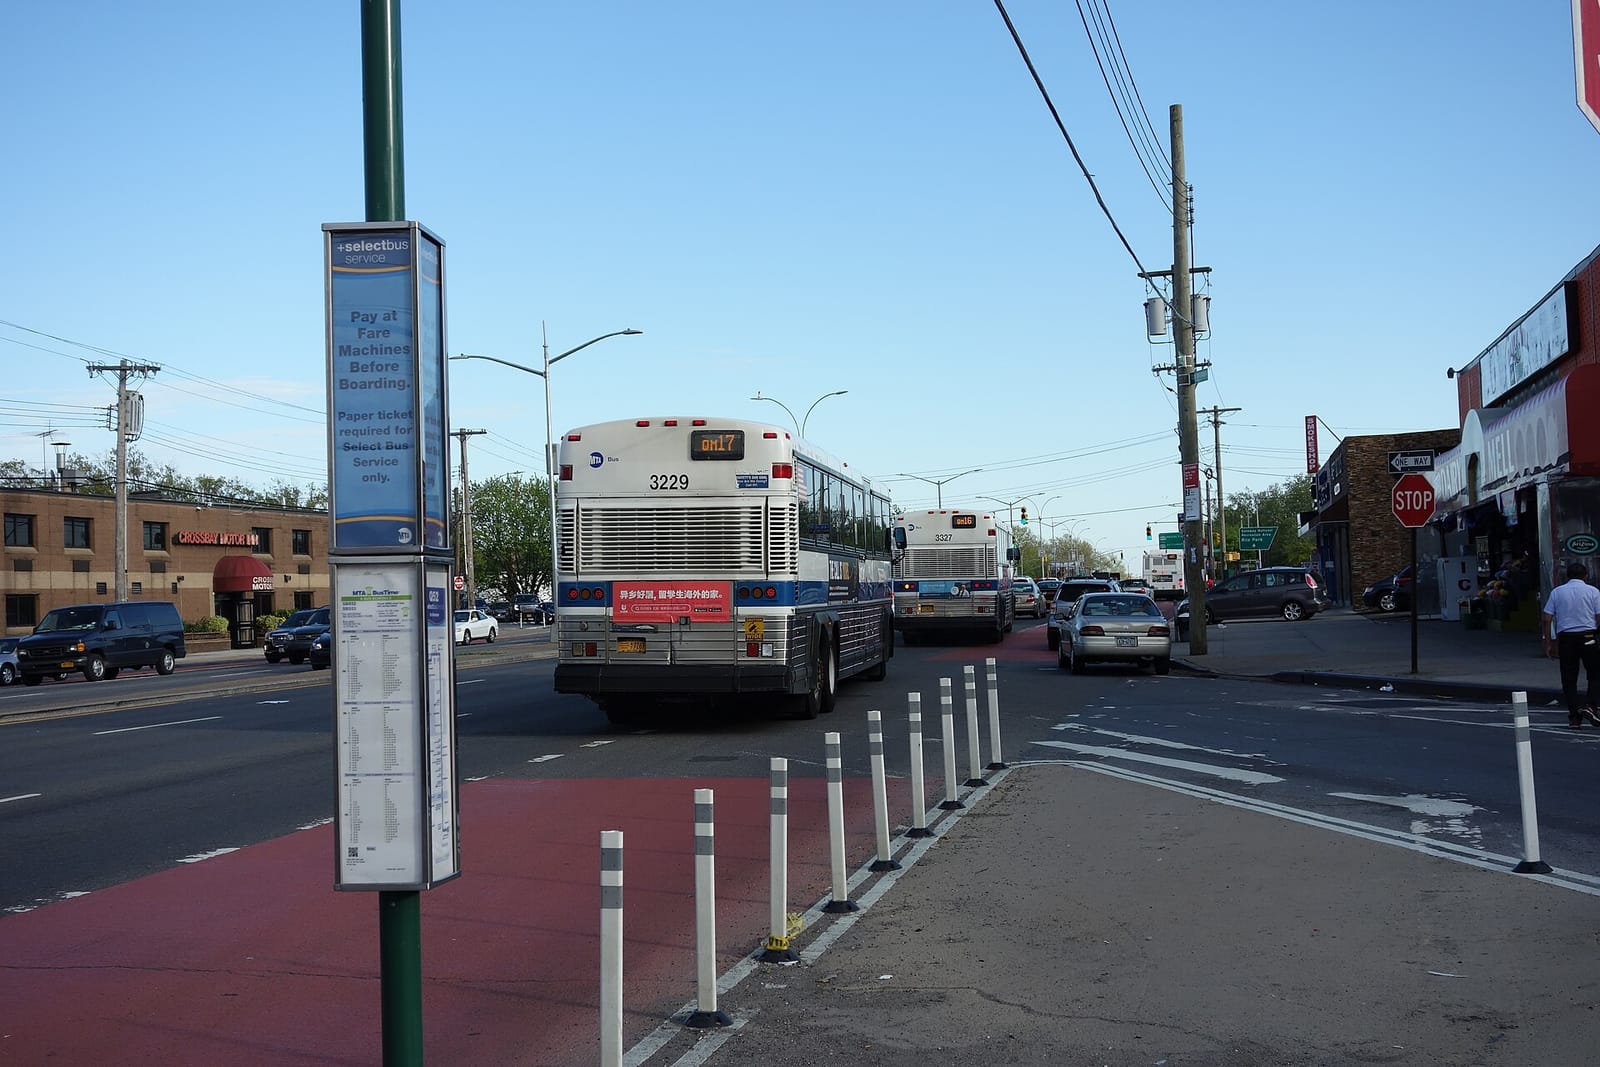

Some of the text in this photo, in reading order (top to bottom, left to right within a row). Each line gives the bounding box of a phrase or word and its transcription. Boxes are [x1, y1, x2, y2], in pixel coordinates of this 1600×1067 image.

[345, 254, 386, 264] service
[351, 311, 397, 323] Pay at
[358, 327, 391, 339] Fare
[339, 344, 411, 356] Machines
[350, 361, 399, 372] Before
[339, 379, 411, 391] Boarding.
[338, 410, 413, 422] Paper ticket
[339, 425, 412, 437] required for
[343, 441, 408, 451] Select Bus
[1308, 418, 1316, 470] SMOKESHOP
[353, 457, 399, 467] Service
[1413, 456, 1428, 465] WAY
[362, 473, 390, 483] only.
[649, 474, 689, 490] 3229
[1396, 491, 1432, 510] STOP
[179, 531, 218, 544] CROSSBAY
[220, 533, 246, 545] MOTOR
[935, 534, 952, 542] 3327
